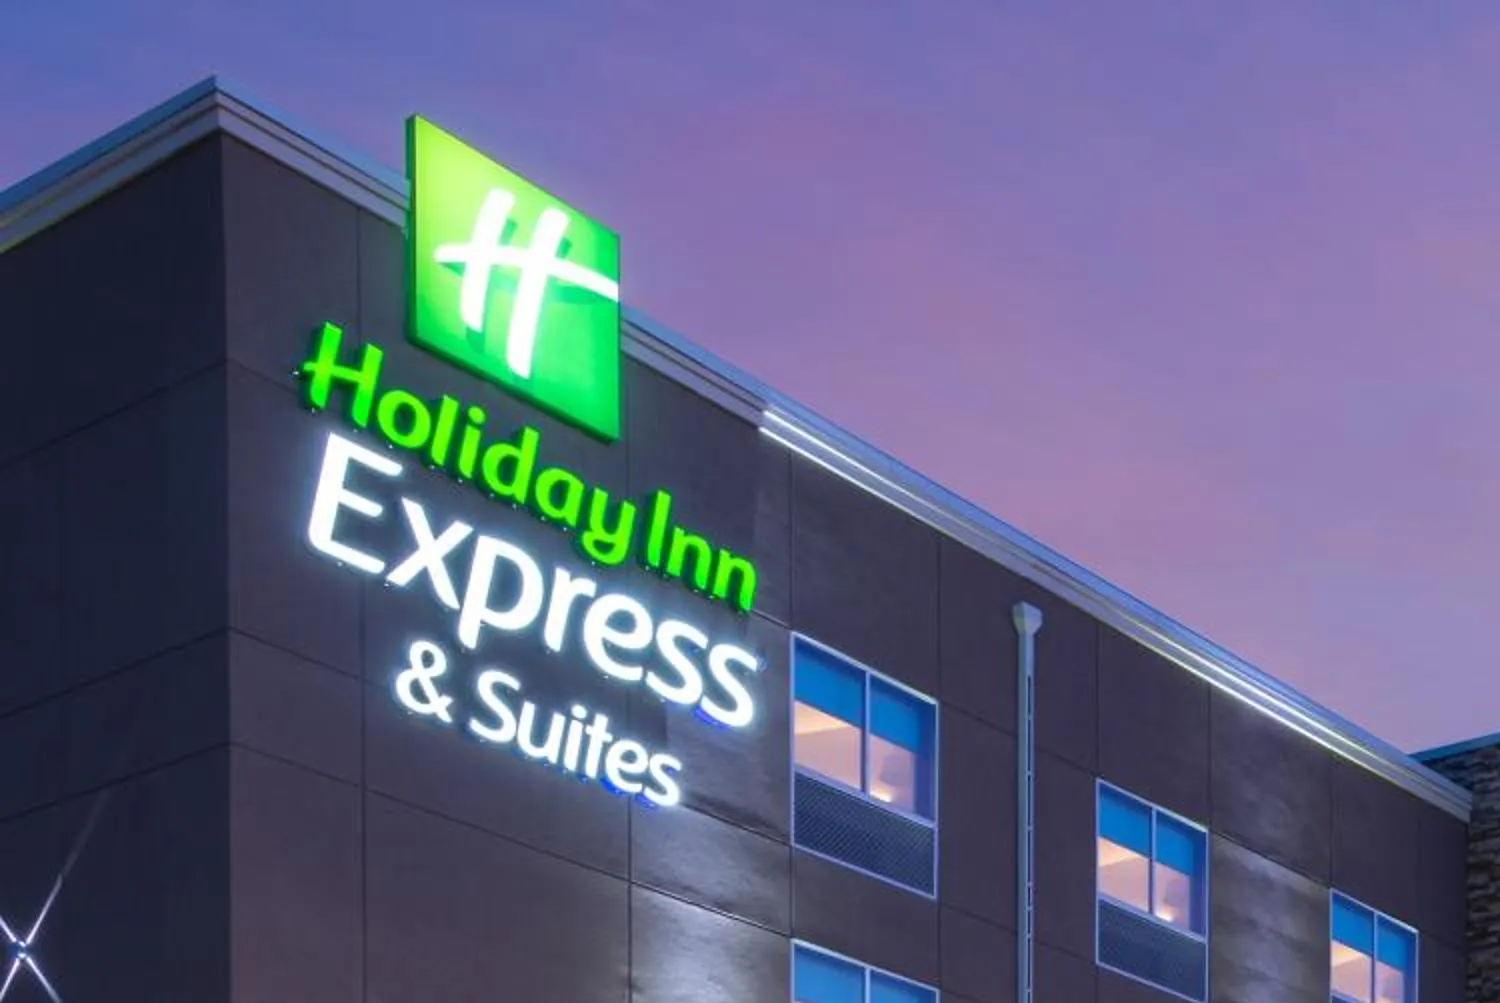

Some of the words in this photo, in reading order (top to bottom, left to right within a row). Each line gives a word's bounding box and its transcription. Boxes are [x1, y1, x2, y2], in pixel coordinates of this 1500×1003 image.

[434, 188, 619, 378] H
[303, 321, 635, 565] Holiday
[645, 489, 756, 611] Inn
[306, 432, 758, 728] Express
[396, 640, 454, 723] &
[470, 671, 681, 807] Suites
